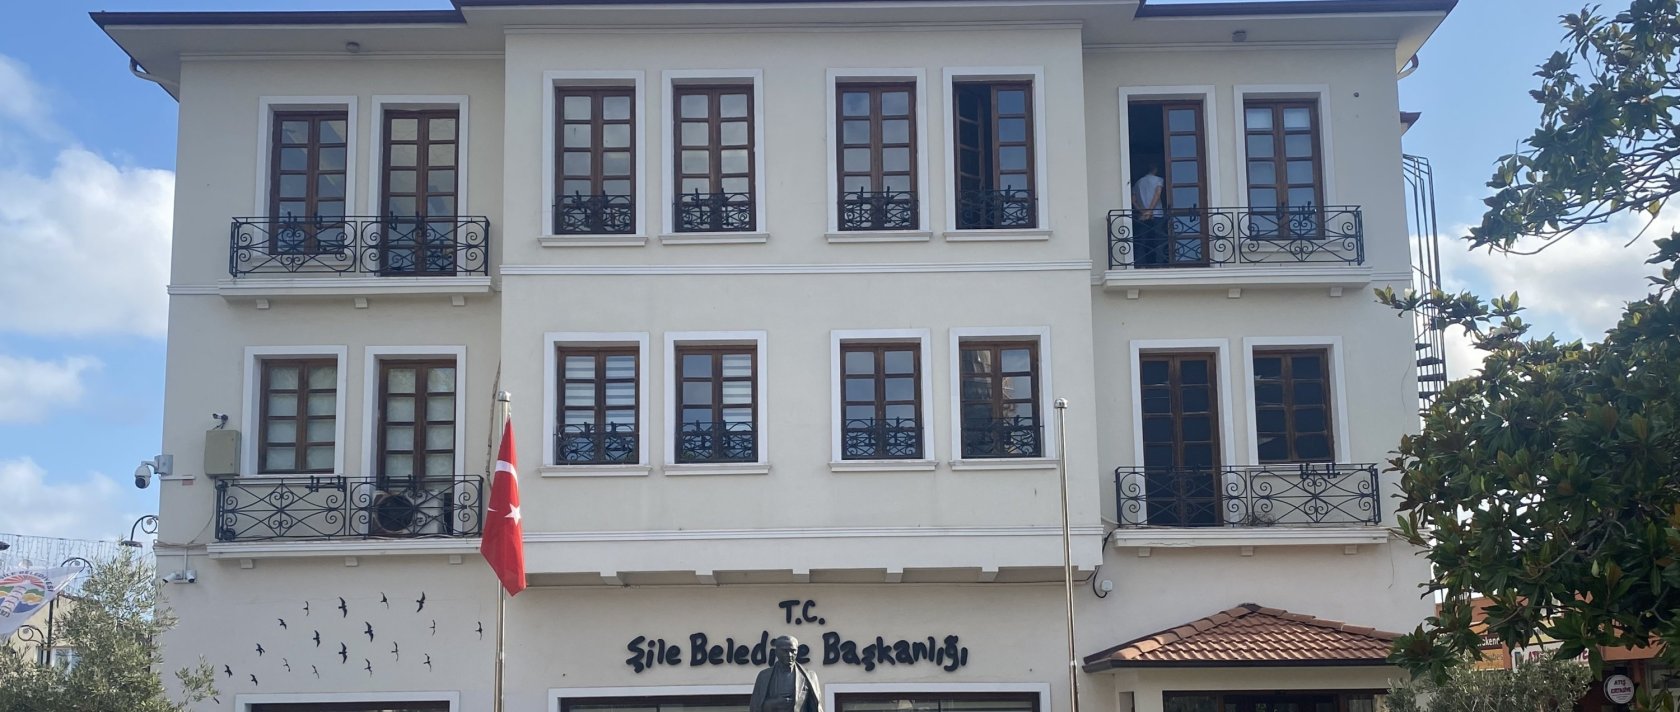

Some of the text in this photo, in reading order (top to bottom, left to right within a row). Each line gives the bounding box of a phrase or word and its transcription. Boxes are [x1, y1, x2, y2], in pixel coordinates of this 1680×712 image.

[779, 600, 826, 625] T.C.
[626, 631, 968, 673] Şile Beledie Başkanlığı
